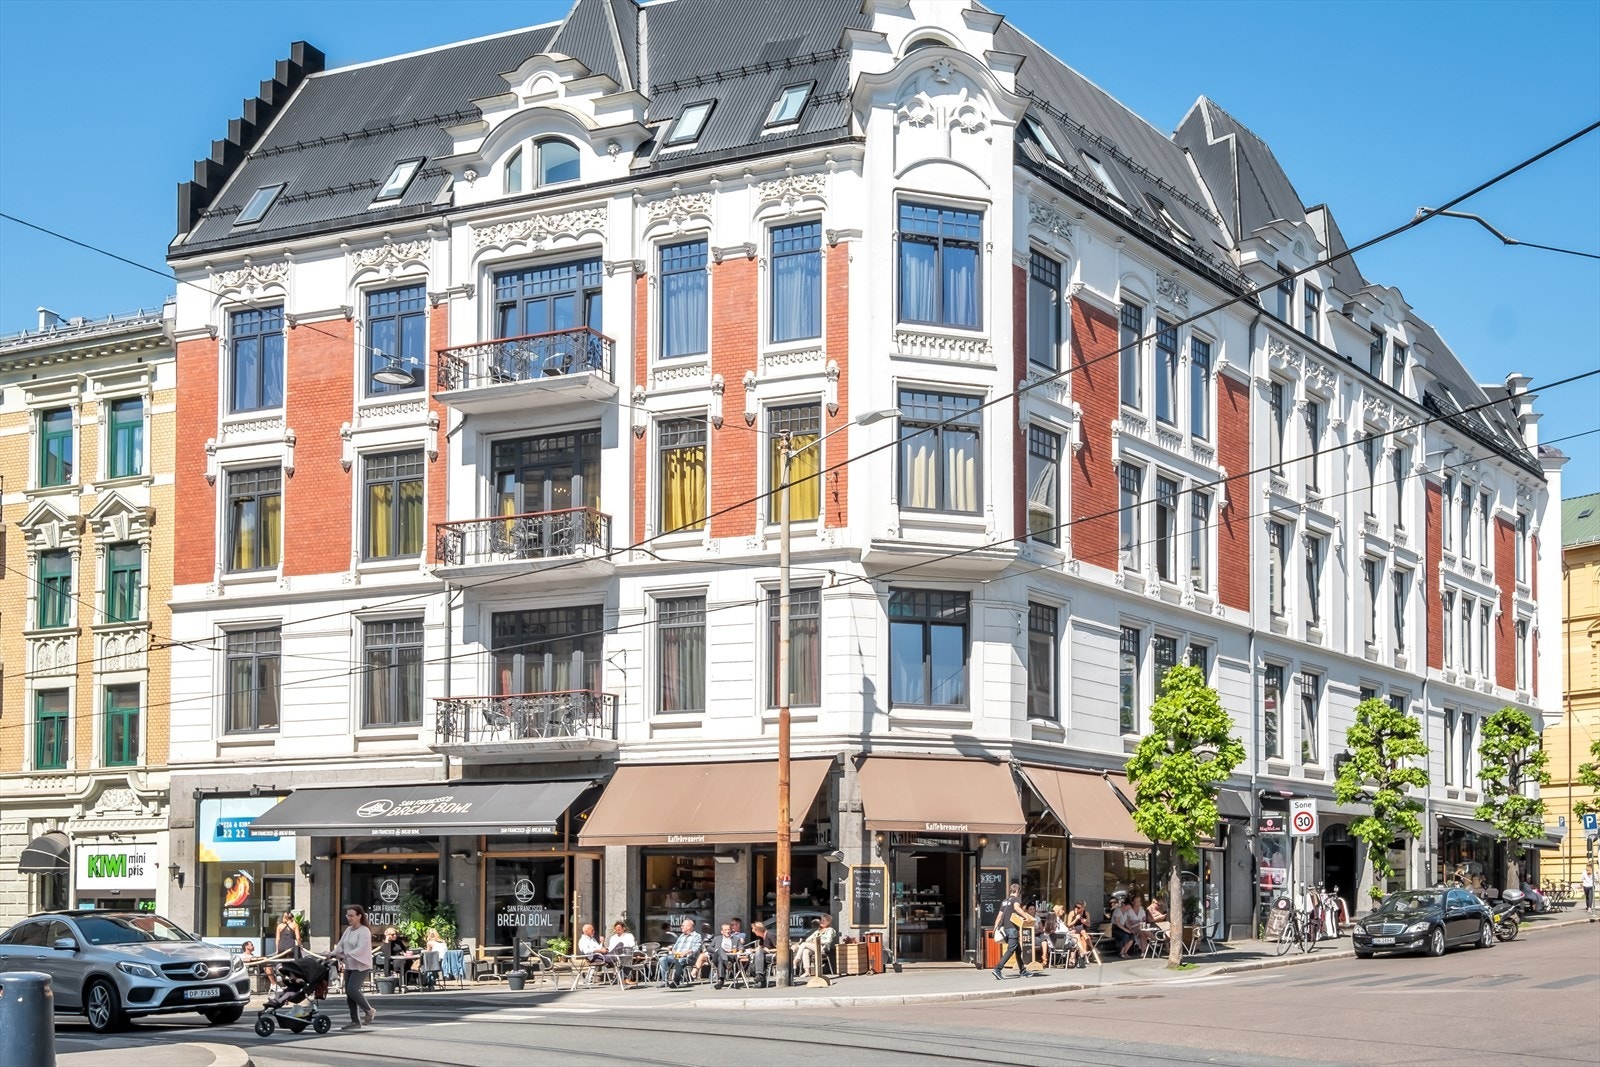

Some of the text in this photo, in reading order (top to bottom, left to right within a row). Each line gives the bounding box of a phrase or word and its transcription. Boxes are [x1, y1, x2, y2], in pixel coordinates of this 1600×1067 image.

[415, 796, 454, 805] FRANCISCO
[1294, 801, 1312, 809] Sone
[386, 802, 472, 817] BREAD BOWL
[925, 822, 968, 832] Kaffebrenneriet
[1297, 816, 1311, 827] 30
[1586, 816, 1594, 828] P
[668, 835, 705, 843] Kaffebrenneriet
[88, 852, 146, 878] KIWI mini
[497, 914, 553, 926] BREAD BOWL
[670, 914, 686, 926] Kaff
